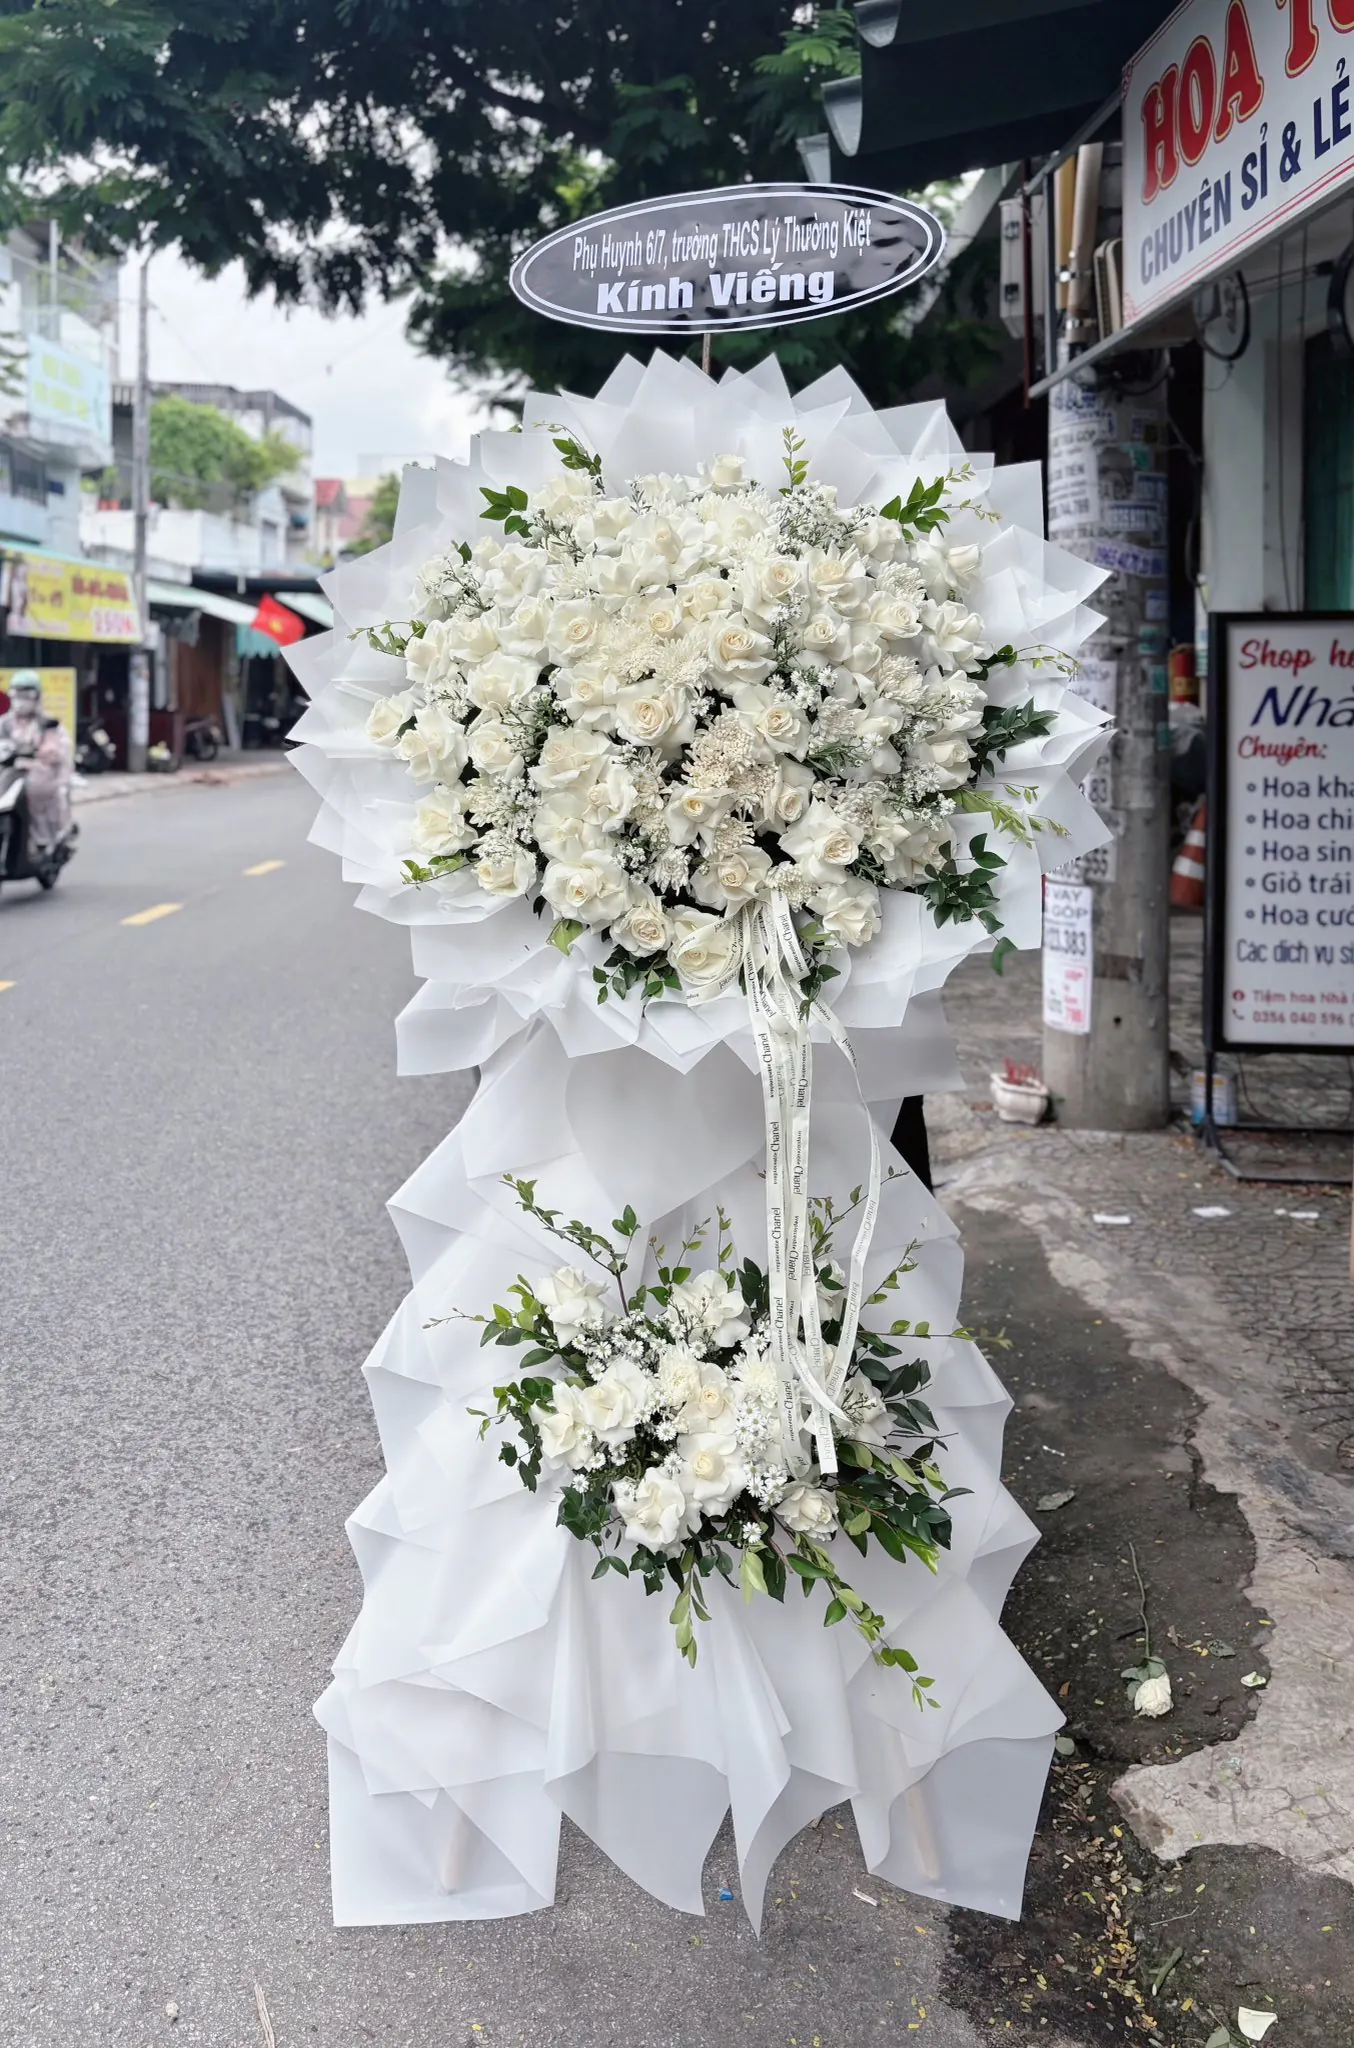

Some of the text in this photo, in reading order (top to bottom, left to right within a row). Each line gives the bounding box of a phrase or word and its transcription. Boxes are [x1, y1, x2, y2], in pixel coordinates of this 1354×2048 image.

[1140, 0, 1265, 206] HOA
[1140, 57, 1352, 286] CHUYÊN SỈ & LẺ
[573, 208, 871, 278] Phụ Huynh 6/7, trường THCS Lý Thường Kiệt
[597, 262, 835, 314] Kính Viếng
[1239, 638, 1316, 677] Shop
[1237, 735, 1328, 767] Chuyên:
[1263, 777, 1310, 798] Hoa
[1262, 809, 1310, 830] Hoa
[1261, 839, 1354, 862] Hoa sin
[1261, 871, 1351, 895] Giỏ trái
[1261, 904, 1308, 926] Hoa
[1236, 938, 1267, 963] Các
[1273, 939, 1308, 964] dịch
[1314, 945, 1334, 967] vụ
[1290, 990, 1316, 1003] hoa
[758, 1032, 773, 1063] Chanel
[796, 1078, 809, 1108] Chanel
[770, 1121, 781, 1152] Chanel
[793, 1165, 804, 1195] Chanel
[771, 1207, 782, 1240] Chanel
[788, 1250, 800, 1281] Chanel
[773, 1296, 785, 1329] Chanel
[781, 1380, 794, 1410] Chanel
